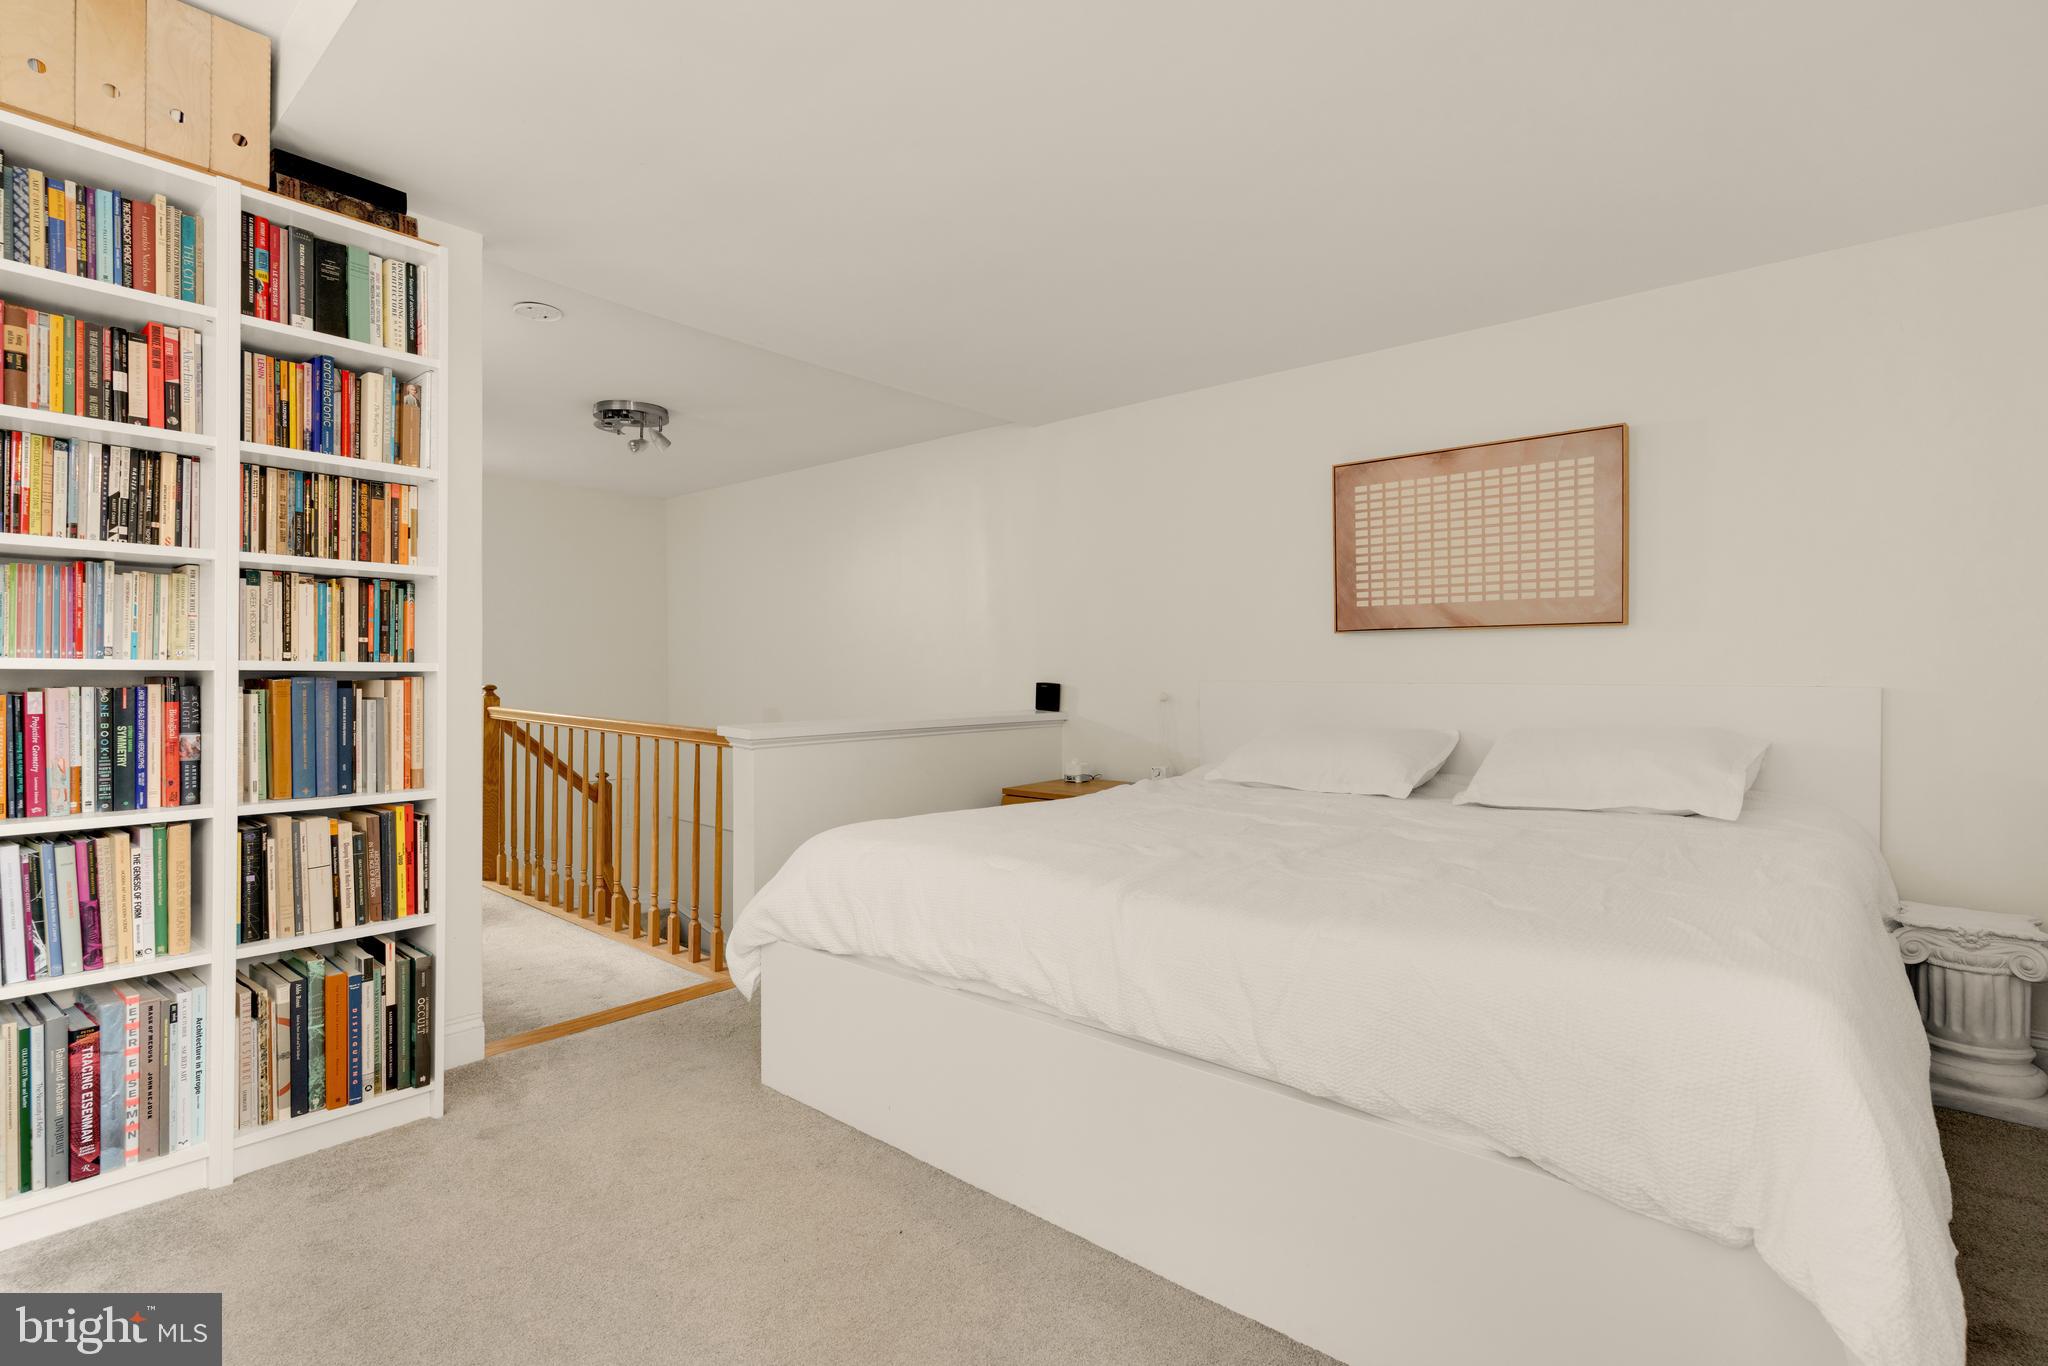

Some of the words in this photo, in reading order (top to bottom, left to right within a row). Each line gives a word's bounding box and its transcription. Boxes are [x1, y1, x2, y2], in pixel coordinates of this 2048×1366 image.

[123, 214, 131, 233] STONES
[142, 215, 150, 250] Leonardo's
[184, 245, 193, 265] THE
[184, 268, 194, 294] CITY
[183, 348, 193, 371] Albert
[65, 367, 74, 385] Brain
[183, 373, 193, 404] Einstein
[32, 437, 40, 476] CONSCIENTIOUS
[32, 478, 40, 509] OBJECTIONS
[31, 716, 40, 743] Projective
[167, 709, 177, 739] Biological
[182, 701, 190, 729] LIGHT
[101, 723, 109, 753] BOOK
[117, 725, 126, 767] SYMMETRY
[31, 745, 40, 773] Geometry
[133, 866, 141, 891] GENESIS
[134, 892, 141, 900] OF
[176, 907, 185, 946] MEANING
[241, 997, 250, 1037] SURFACE
[417, 998, 426, 1035] OCCULT
[56, 1048, 65, 1081] Raimund
[82, 1046, 93, 1089] TRACING
[242, 1050, 250, 1086] SYMBOL
[35, 1093, 43, 1115] Necessity
[56, 1083, 65, 1116] Abraham
[81, 1092, 93, 1143] EISENMAN
[55, 1117, 65, 1155] [UN]BUILT
